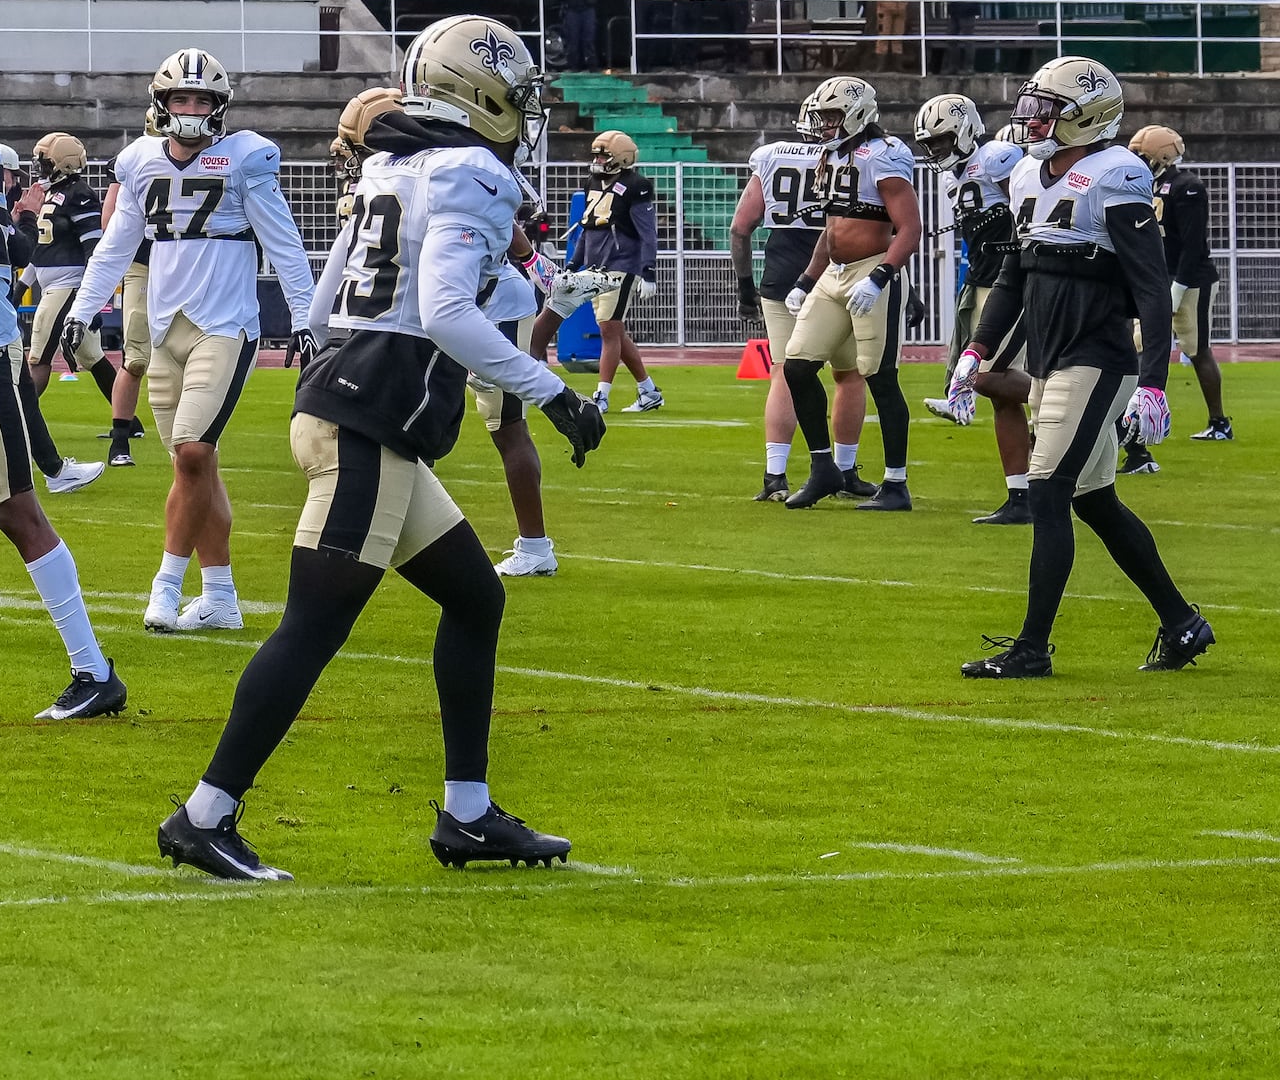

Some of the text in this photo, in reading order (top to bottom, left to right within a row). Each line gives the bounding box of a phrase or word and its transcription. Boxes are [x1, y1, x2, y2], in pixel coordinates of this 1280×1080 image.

[200, 156, 230, 167] ROUSES
[144, 178, 225, 241] 47
[1017, 197, 1076, 230] 44
